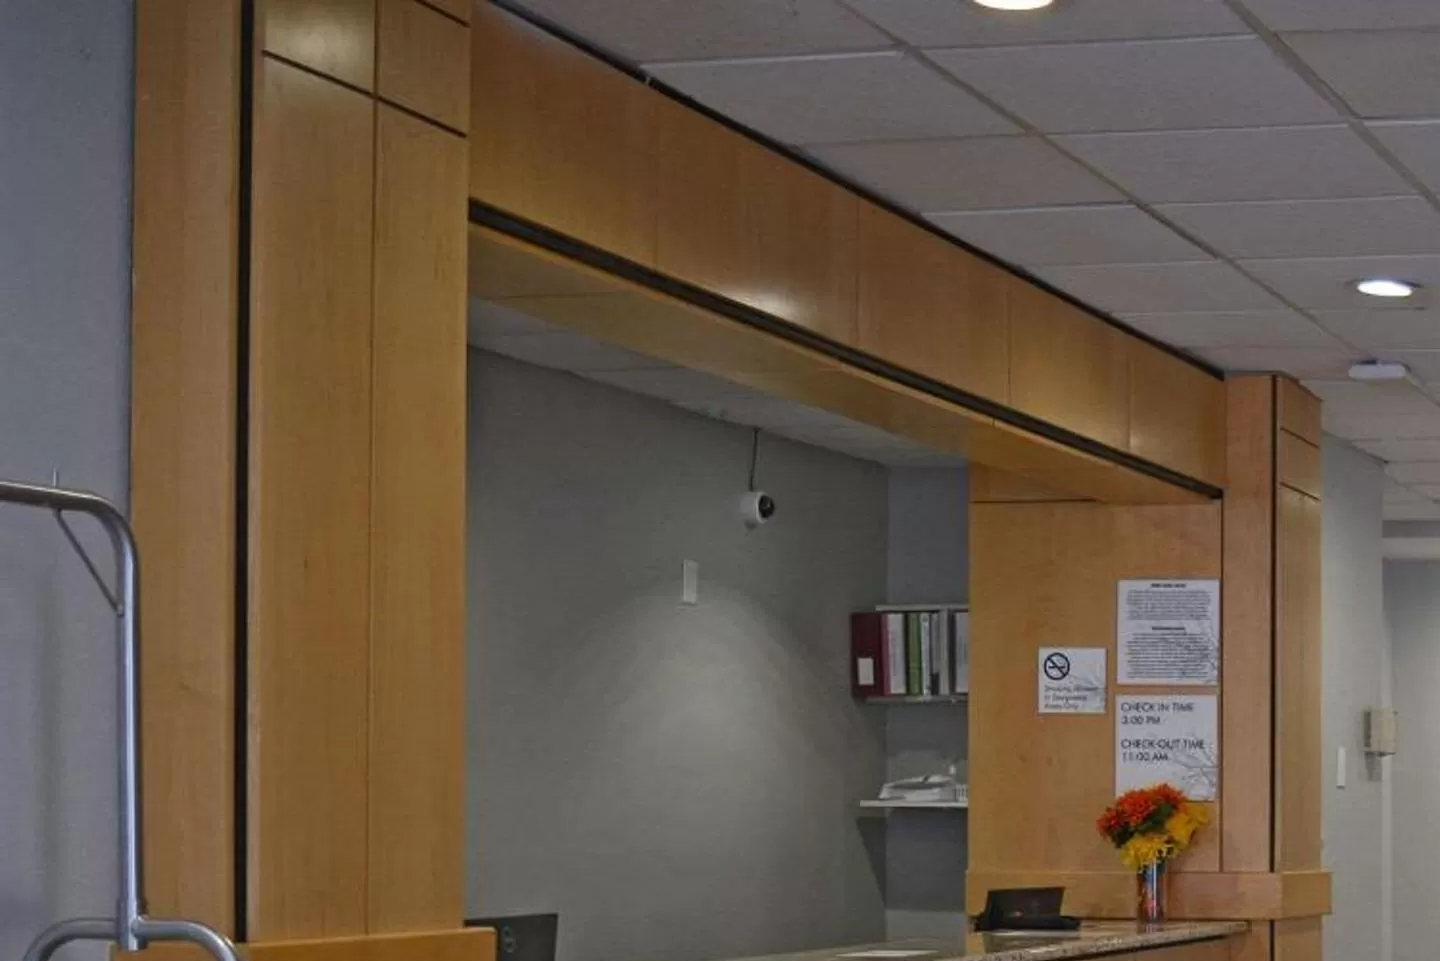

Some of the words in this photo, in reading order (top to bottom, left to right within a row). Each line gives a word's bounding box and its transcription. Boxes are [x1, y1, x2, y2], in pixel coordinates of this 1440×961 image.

[1120, 702, 1154, 713] CHECK
[1172, 702, 1195, 713] TIME
[1146, 715, 1161, 725] PM
[1182, 738, 1206, 749] TIME
